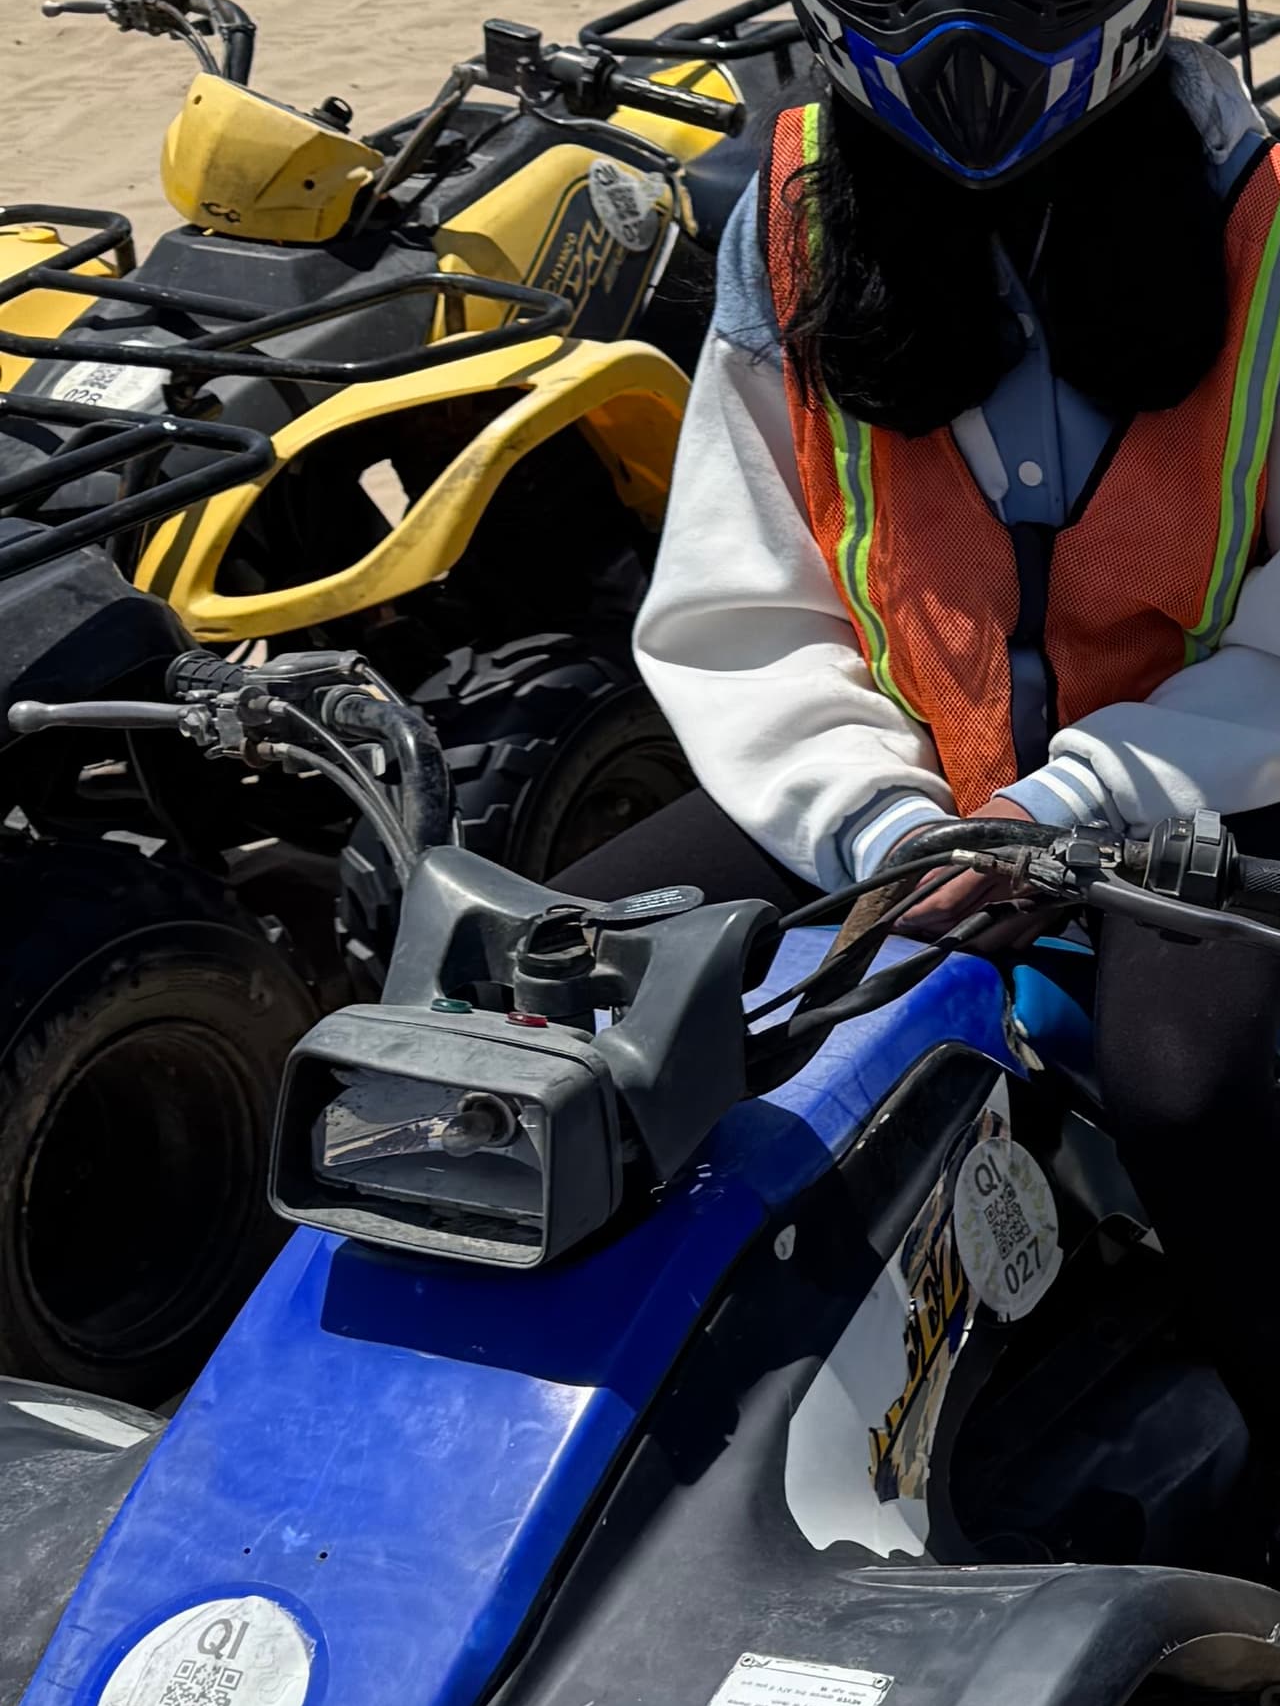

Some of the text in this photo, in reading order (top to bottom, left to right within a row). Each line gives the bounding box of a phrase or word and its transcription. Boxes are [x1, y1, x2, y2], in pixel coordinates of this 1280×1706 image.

[974, 1155, 1003, 1198] QI
[1004, 1242, 1044, 1295] 027
[197, 1618, 250, 1660] QI
